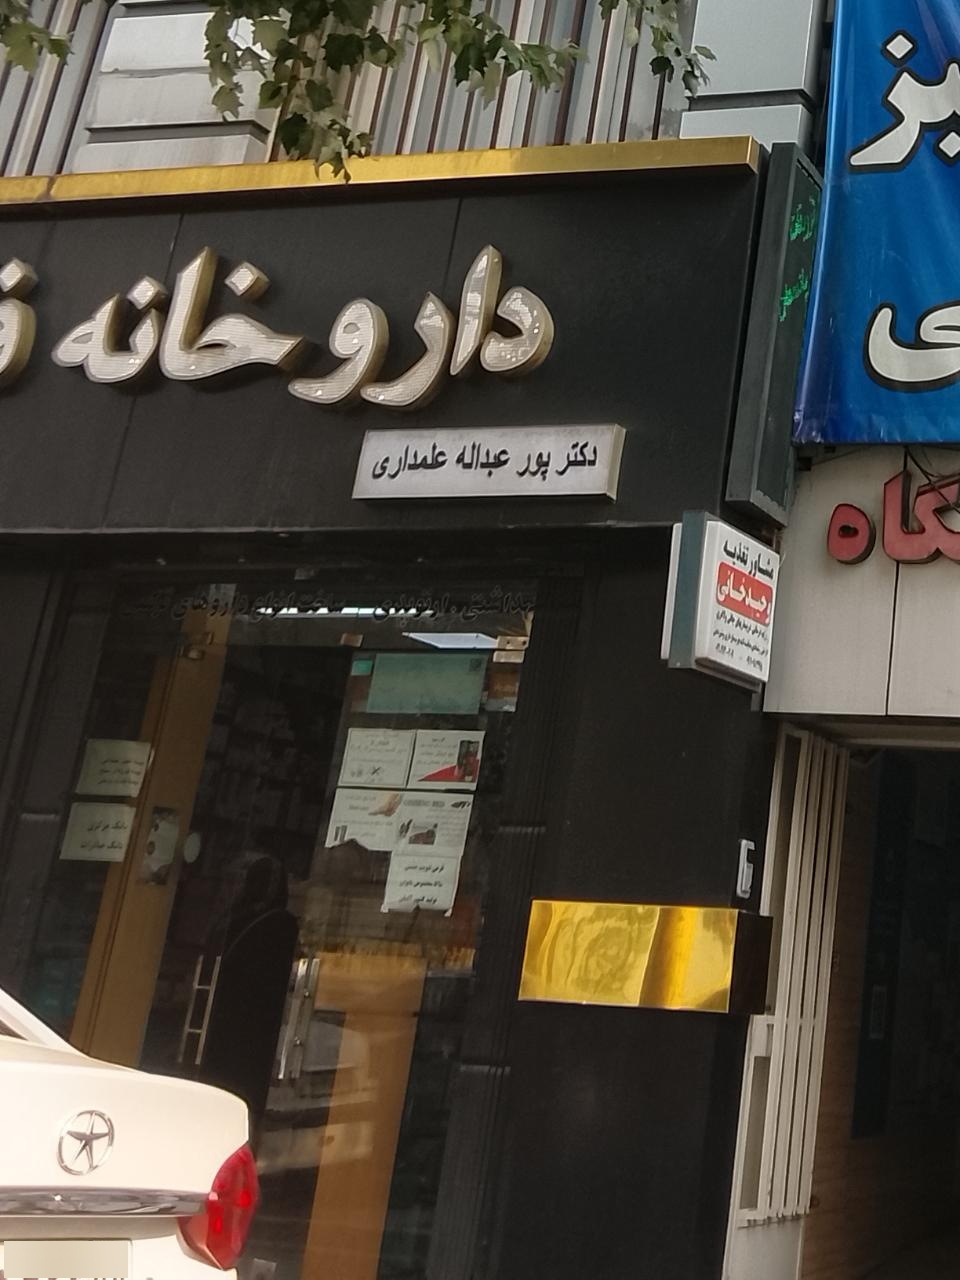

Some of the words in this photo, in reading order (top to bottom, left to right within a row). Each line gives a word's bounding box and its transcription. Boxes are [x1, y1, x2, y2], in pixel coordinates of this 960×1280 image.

[371, 442, 449, 479] علمداری
[455, 441, 510, 477] عبداله
[516, 449, 551, 481] پور
[555, 441, 599, 475] دکتر
